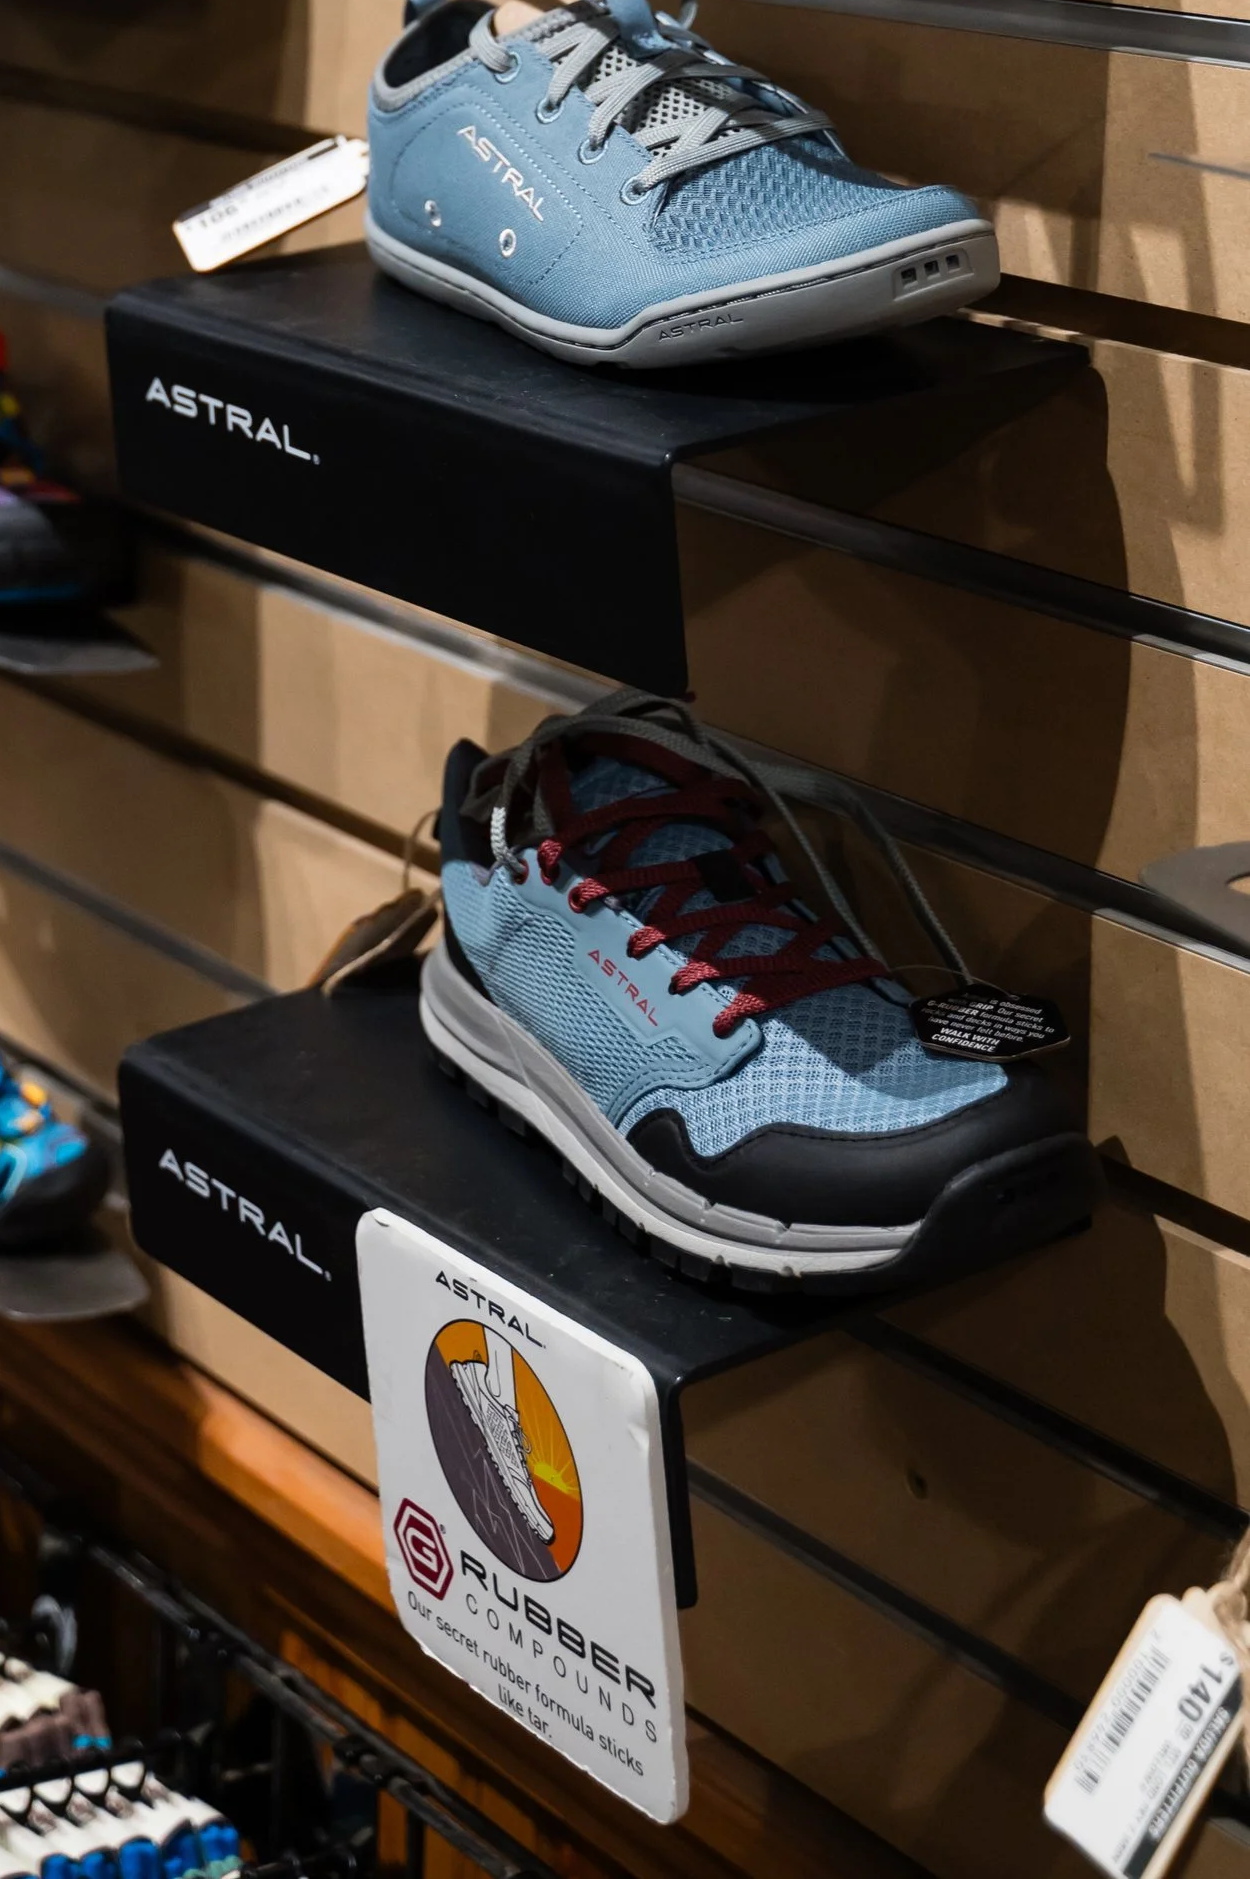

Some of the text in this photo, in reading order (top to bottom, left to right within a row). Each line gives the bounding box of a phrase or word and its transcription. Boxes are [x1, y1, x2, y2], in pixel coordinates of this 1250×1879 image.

[456, 125, 544, 222] ASTRAL
[658, 313, 744, 343] ASTRAL
[587, 949, 659, 1028] ASTRAL
[979, 1011, 1015, 1024] formula
[1014, 1020, 1044, 1031] sticks
[997, 1007, 1014, 1016] Our
[1014, 1012, 1044, 1023] secret
[999, 1001, 1043, 1015] obsessed
[940, 1027, 1001, 1046] WALK WITH
[946, 1013, 966, 1021] and
[965, 1017, 992, 1027] decks
[1003, 1025, 1028, 1035] ways
[1026, 1031, 1046, 1039] you
[950, 1021, 976, 1031] never
[976, 1026, 994, 1035] felt
[931, 1033, 997, 1052] CONFIDENCE
[459, 1549, 657, 1710] RUBBER
[407, 1590, 645, 1777] Our secret rubber formula sticks
[465, 1593, 658, 1744] COMPOUNDS
[1177, 1662, 1224, 1724] 140
[497, 1682, 553, 1739] like tar.
